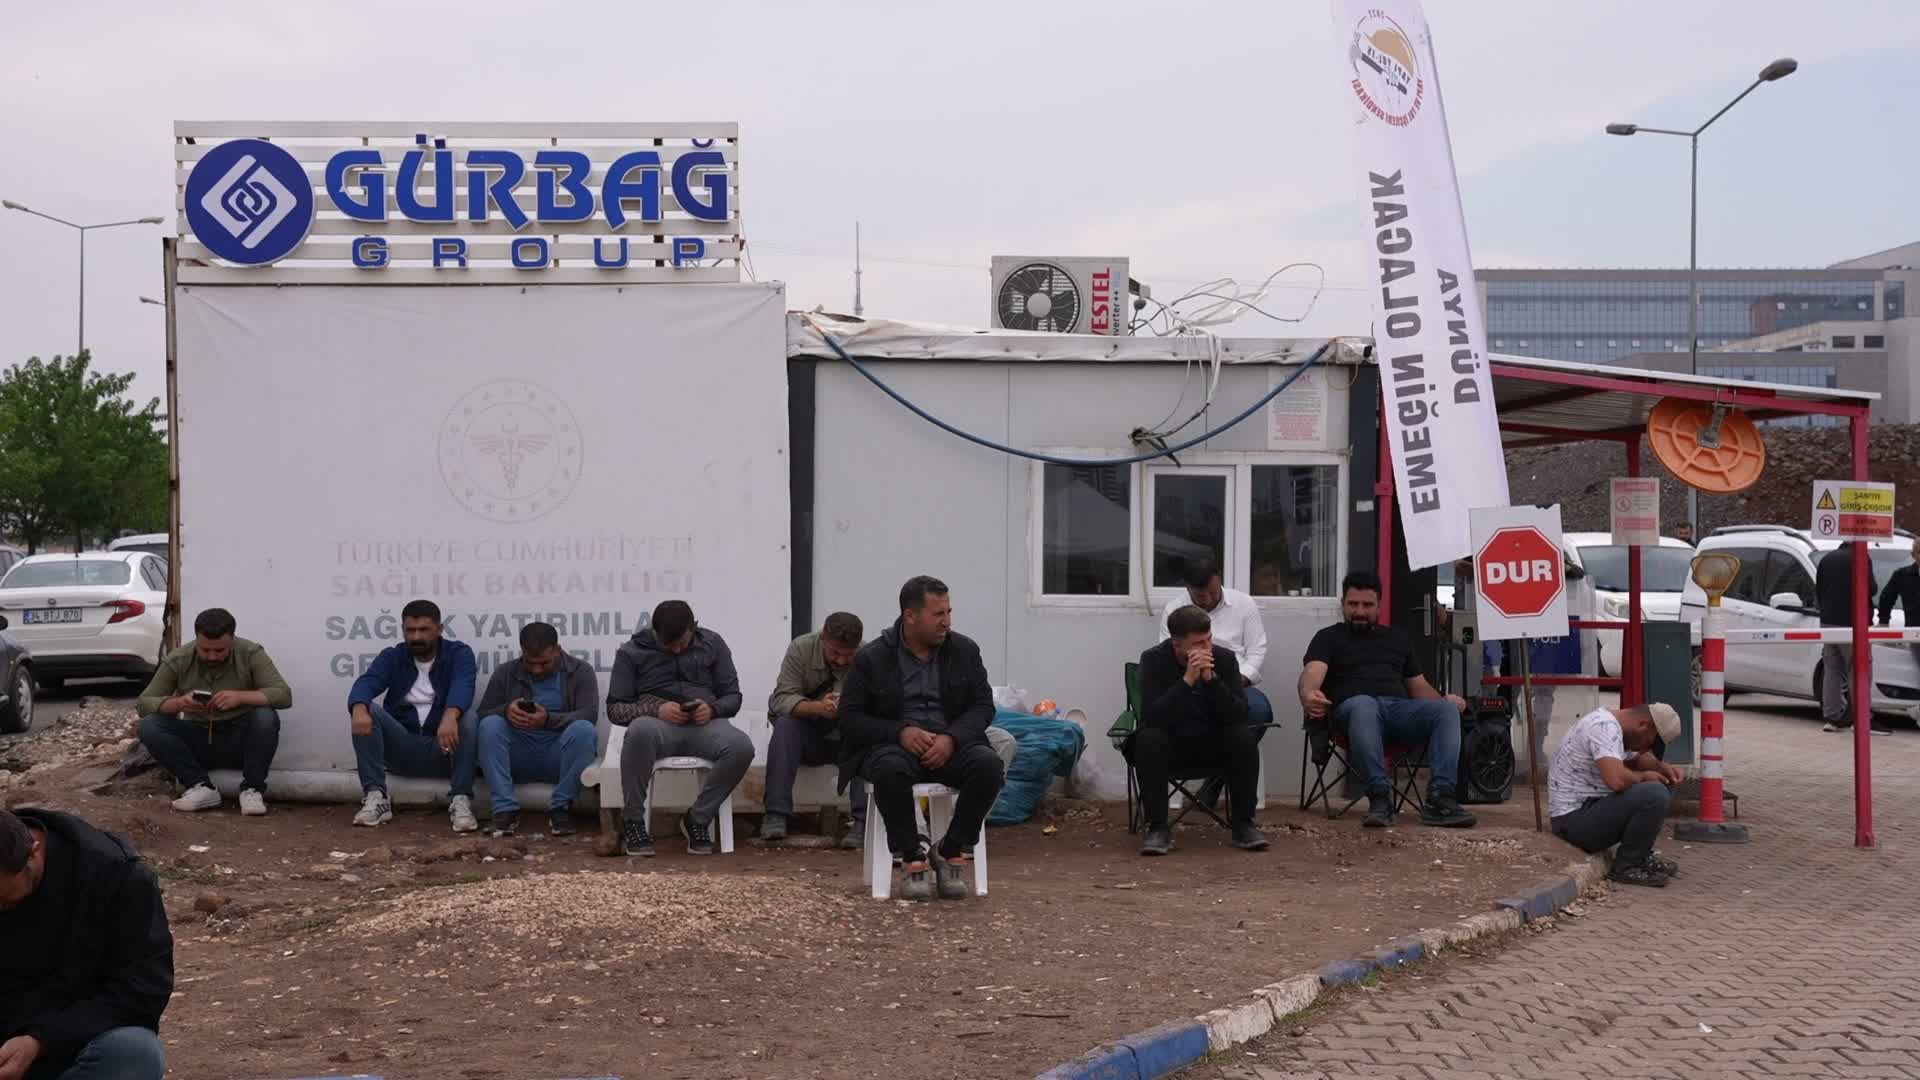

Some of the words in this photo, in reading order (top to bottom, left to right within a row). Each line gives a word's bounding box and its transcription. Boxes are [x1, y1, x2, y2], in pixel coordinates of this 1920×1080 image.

[324, 132, 730, 231] GÜRBAĞ
[351, 237, 708, 270] GROUP
[331, 564, 469, 598] SAĞLIK
[485, 562, 694, 596] BAKANLIĞI
[1486, 559, 1553, 584] DUR
